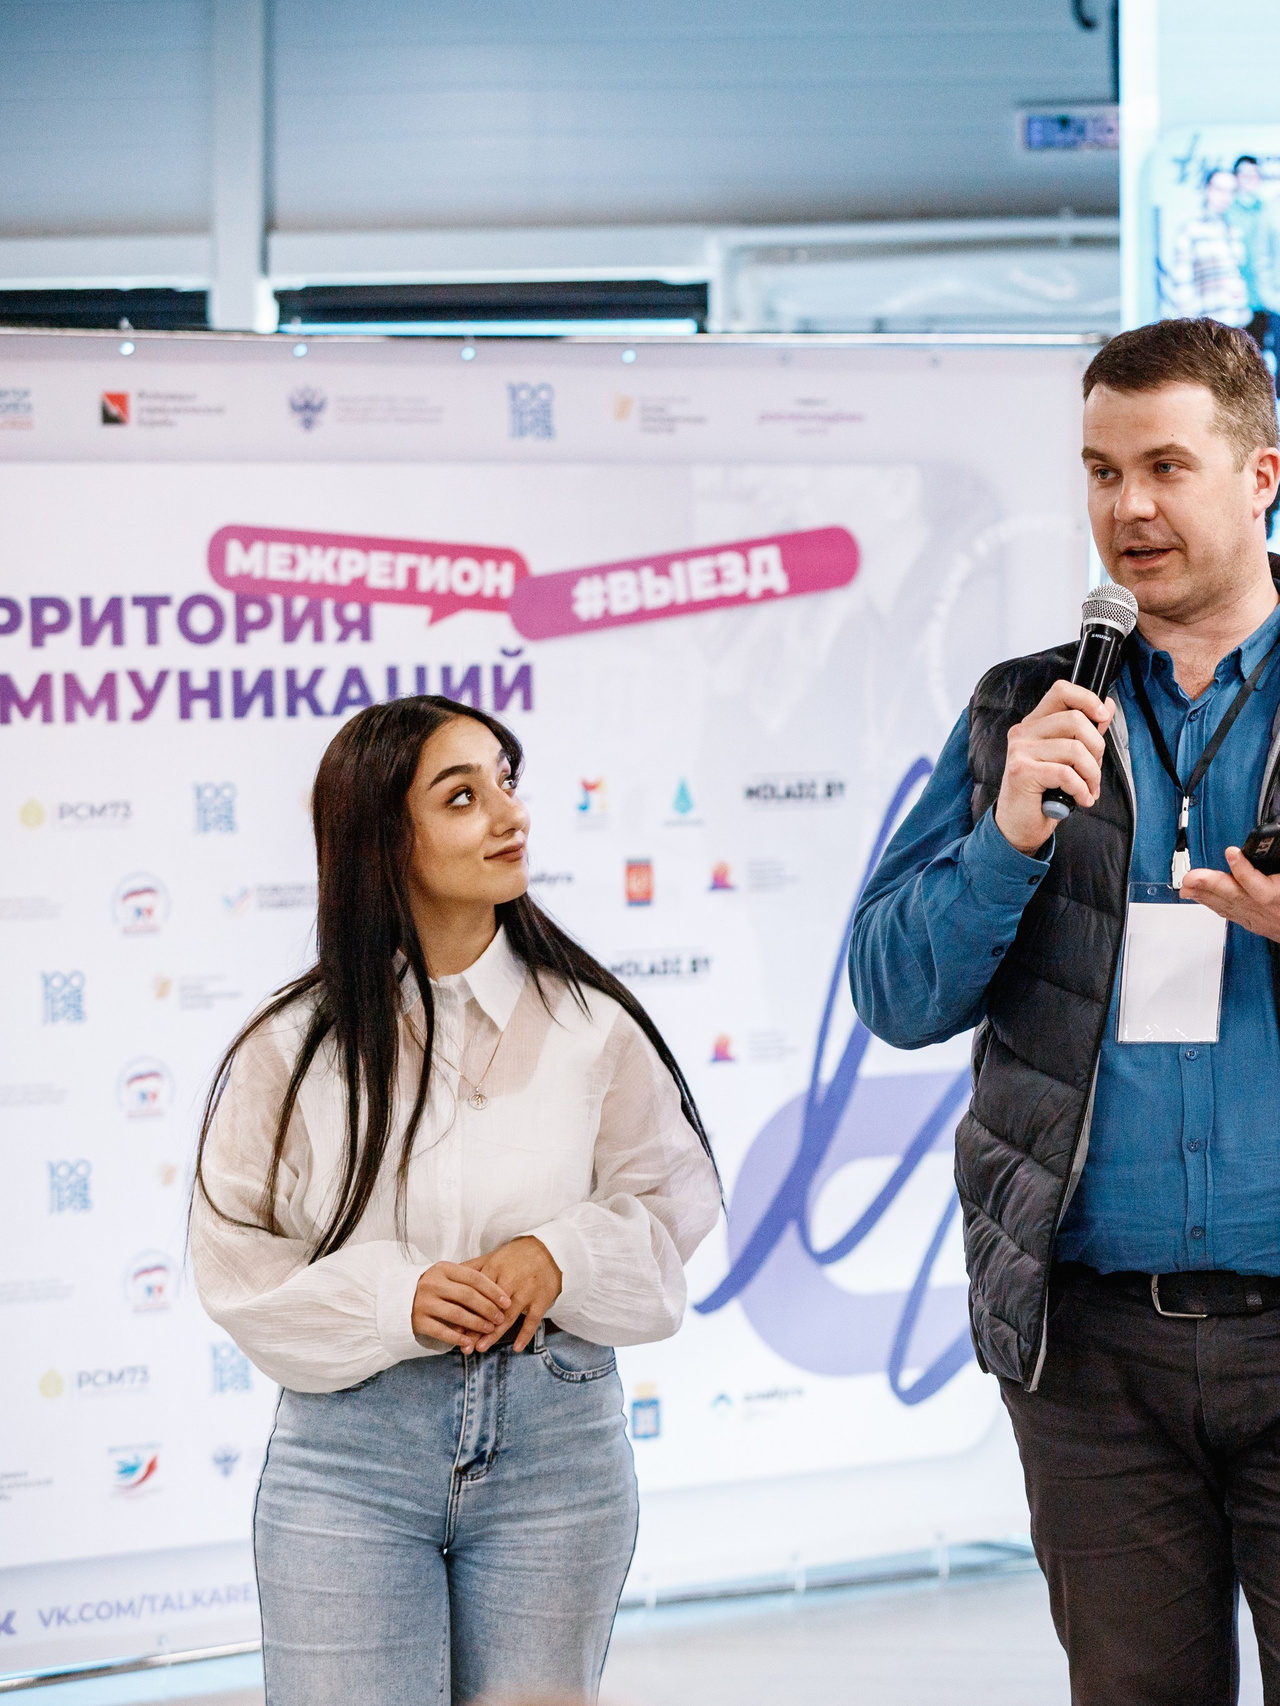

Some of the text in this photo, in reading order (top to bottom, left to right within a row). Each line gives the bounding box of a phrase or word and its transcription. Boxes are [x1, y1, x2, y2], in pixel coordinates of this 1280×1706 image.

[225, 539, 515, 598] МЕЖРЕГИОН
[573, 545, 789, 620] #ВЫЕЗД
[37, 1582, 260, 1629] VK.COM/TALKARE
